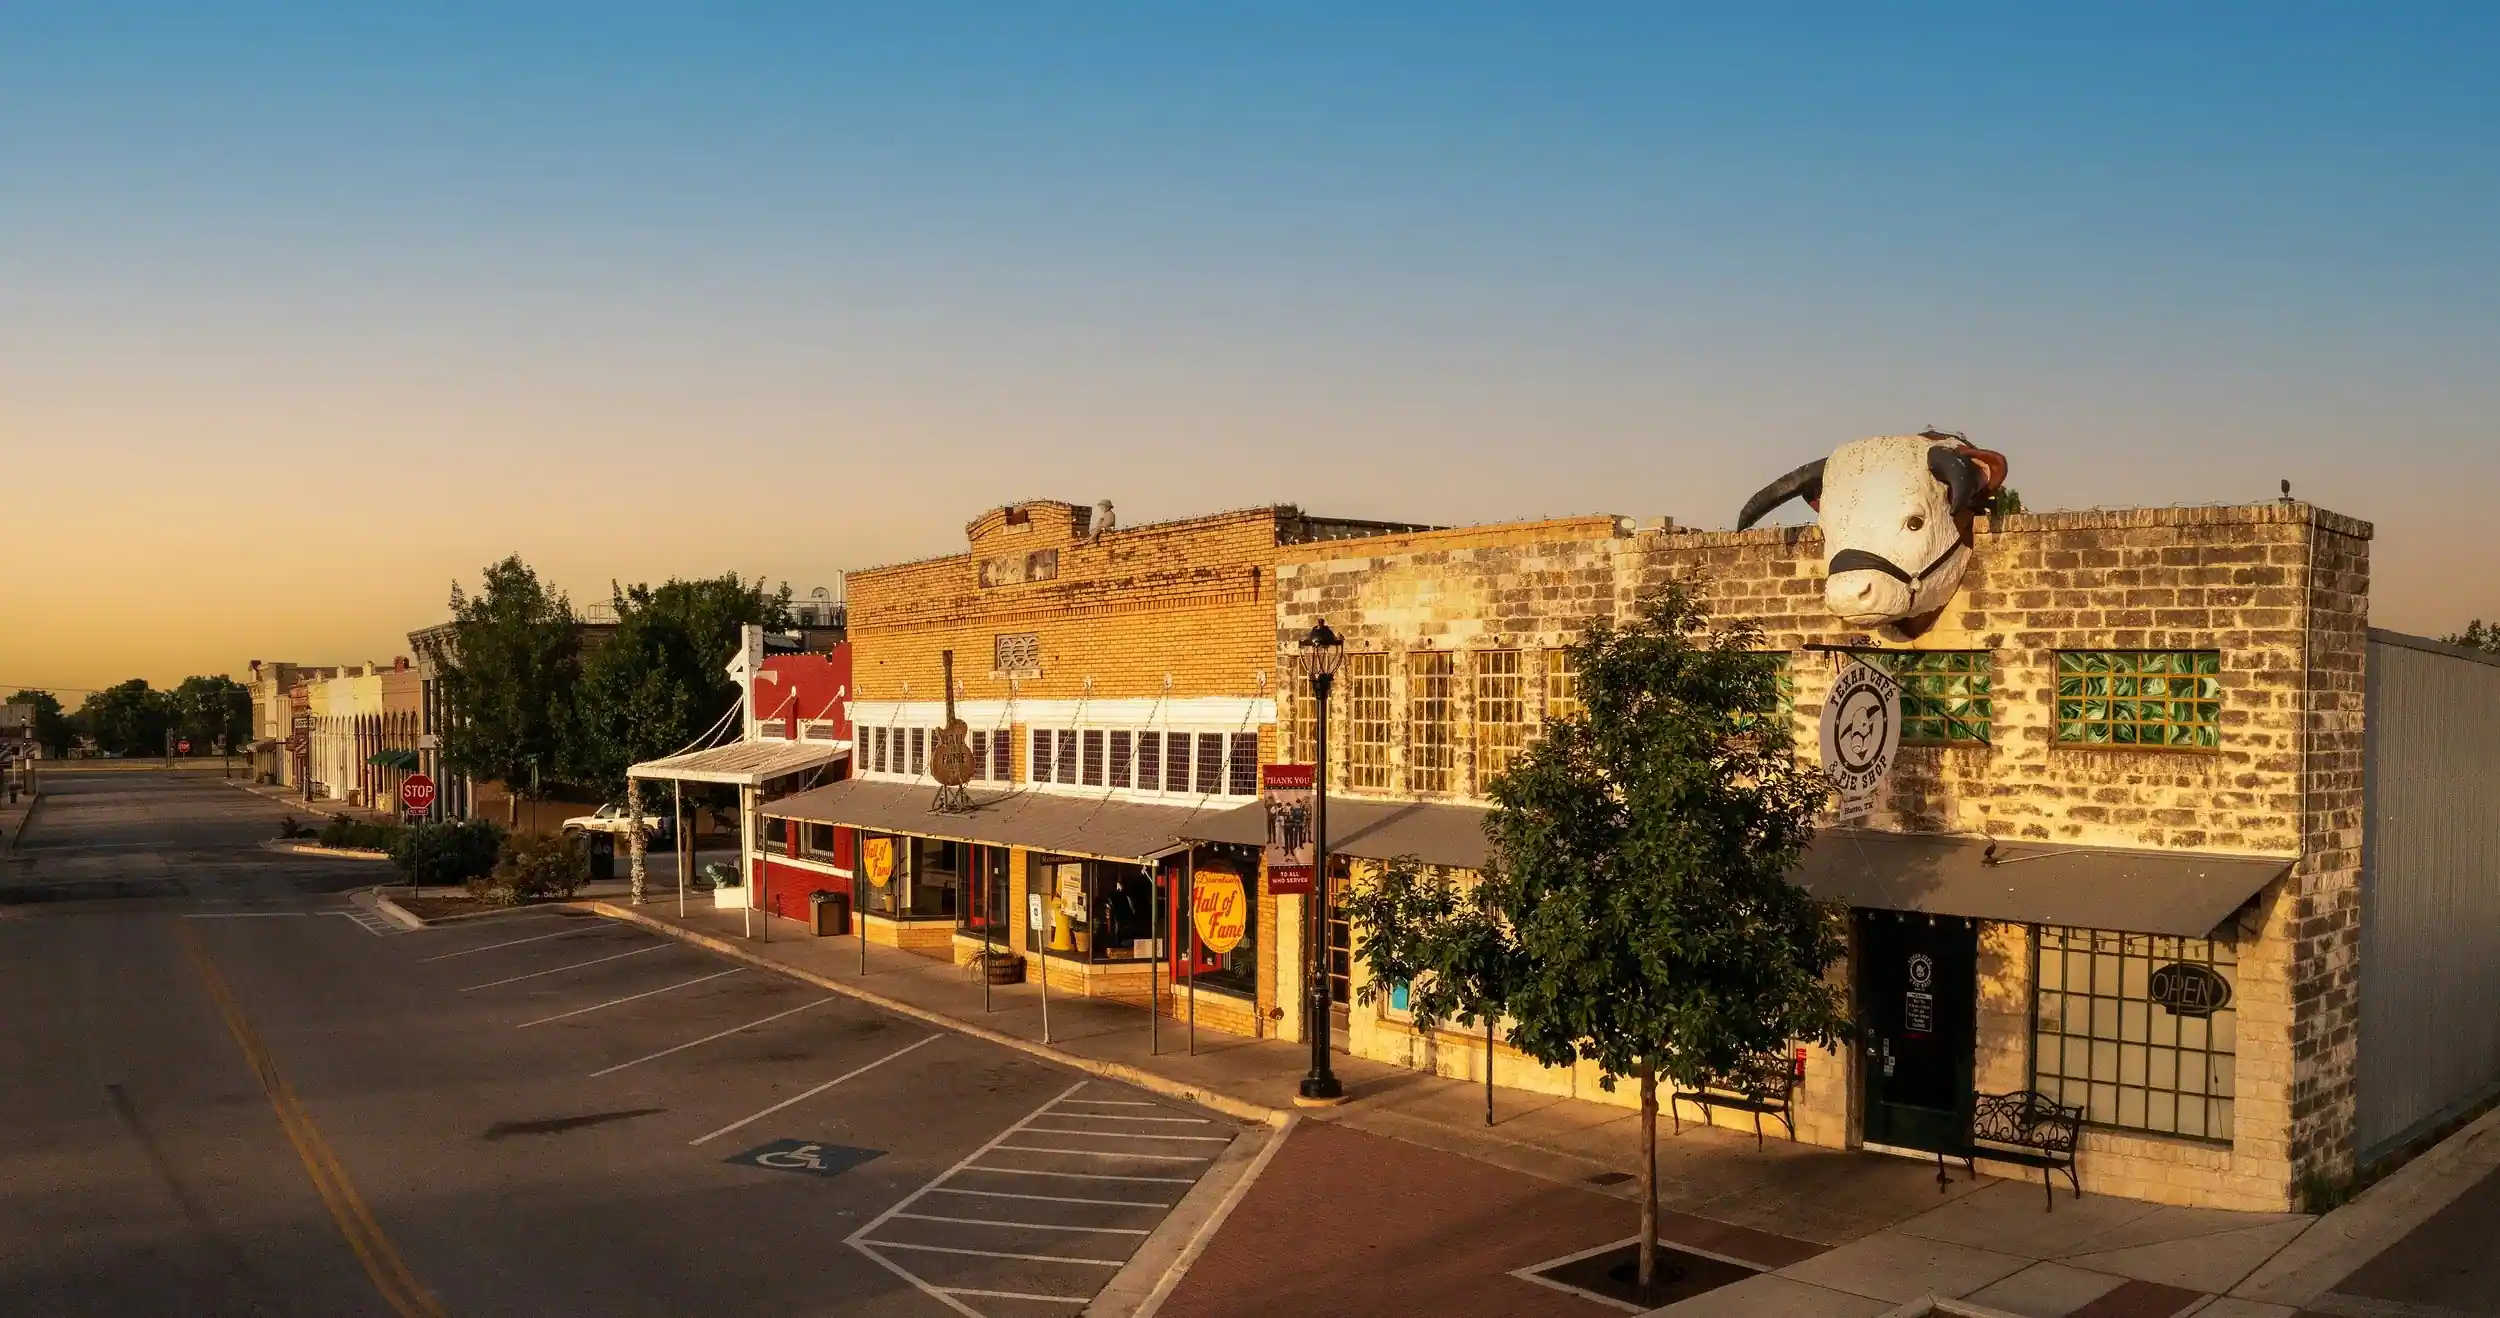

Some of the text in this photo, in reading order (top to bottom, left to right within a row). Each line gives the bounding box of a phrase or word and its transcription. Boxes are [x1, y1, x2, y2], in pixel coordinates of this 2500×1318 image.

[1830, 667, 1866, 706] TEXAN
[942, 752, 967, 765] FAME
[1829, 754, 1887, 791] & PIE SHOP
[404, 785, 434, 798] STOP
[1266, 776, 1310, 785] THANK YOU
[1864, 801, 1874, 810] TX
[1193, 886, 1237, 917] Hall of
[1208, 911, 1244, 939] Fame
[2152, 972, 2215, 1005] OPEN
